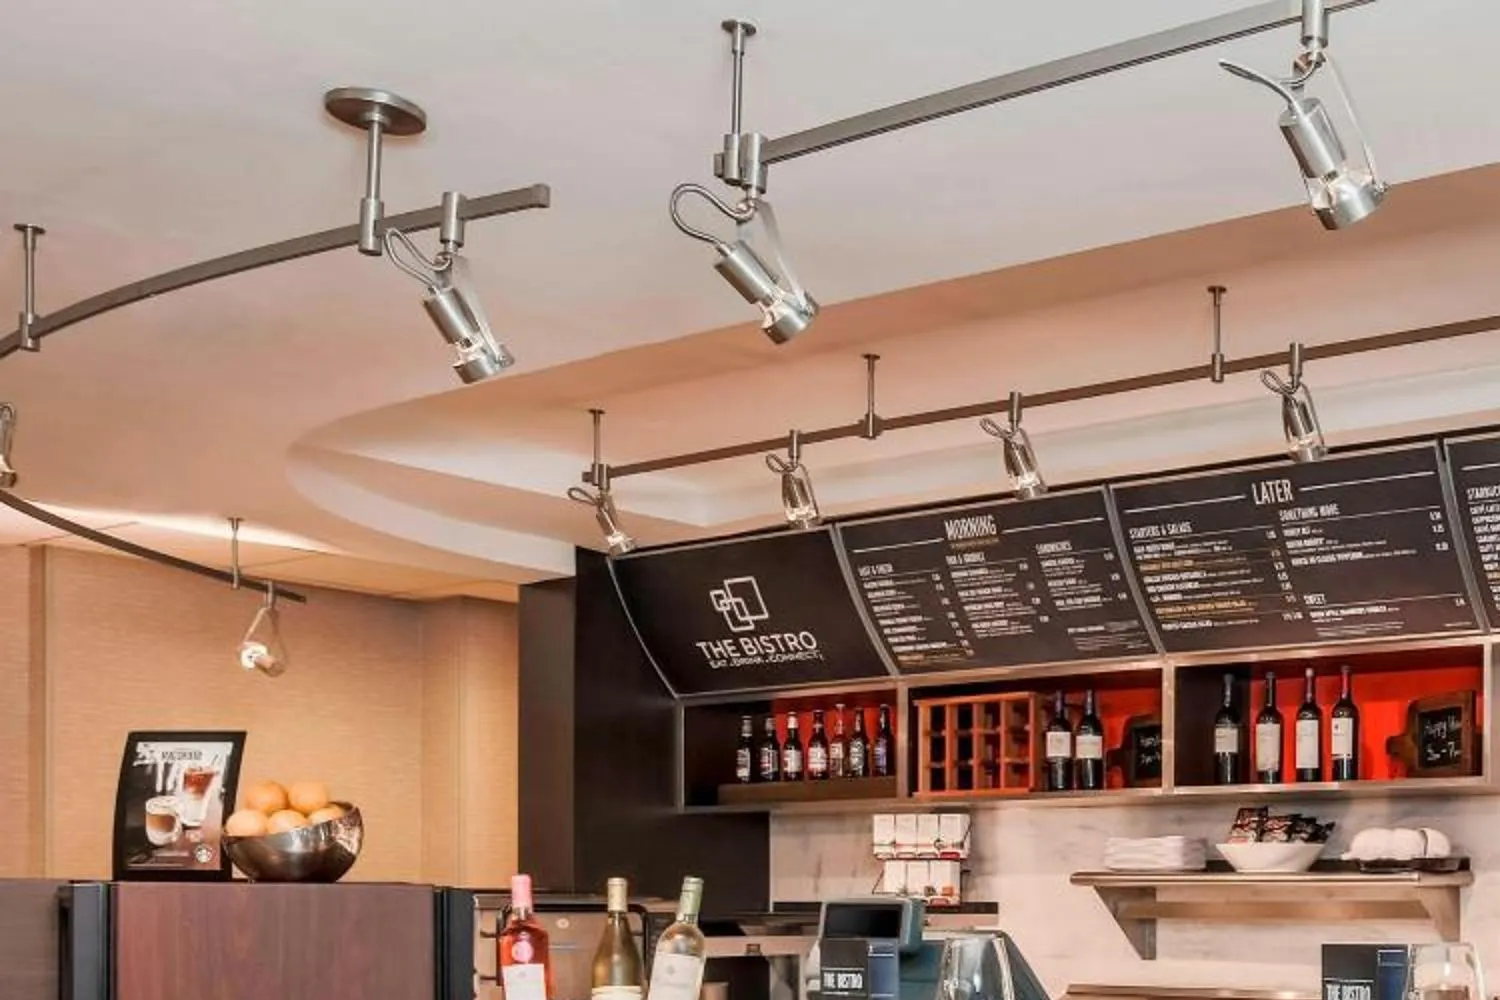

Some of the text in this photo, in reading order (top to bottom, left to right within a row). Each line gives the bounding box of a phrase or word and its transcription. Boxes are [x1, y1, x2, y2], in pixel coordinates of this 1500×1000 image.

[1251, 479, 1294, 505] LATER
[695, 631, 817, 659] THE BISTRO
